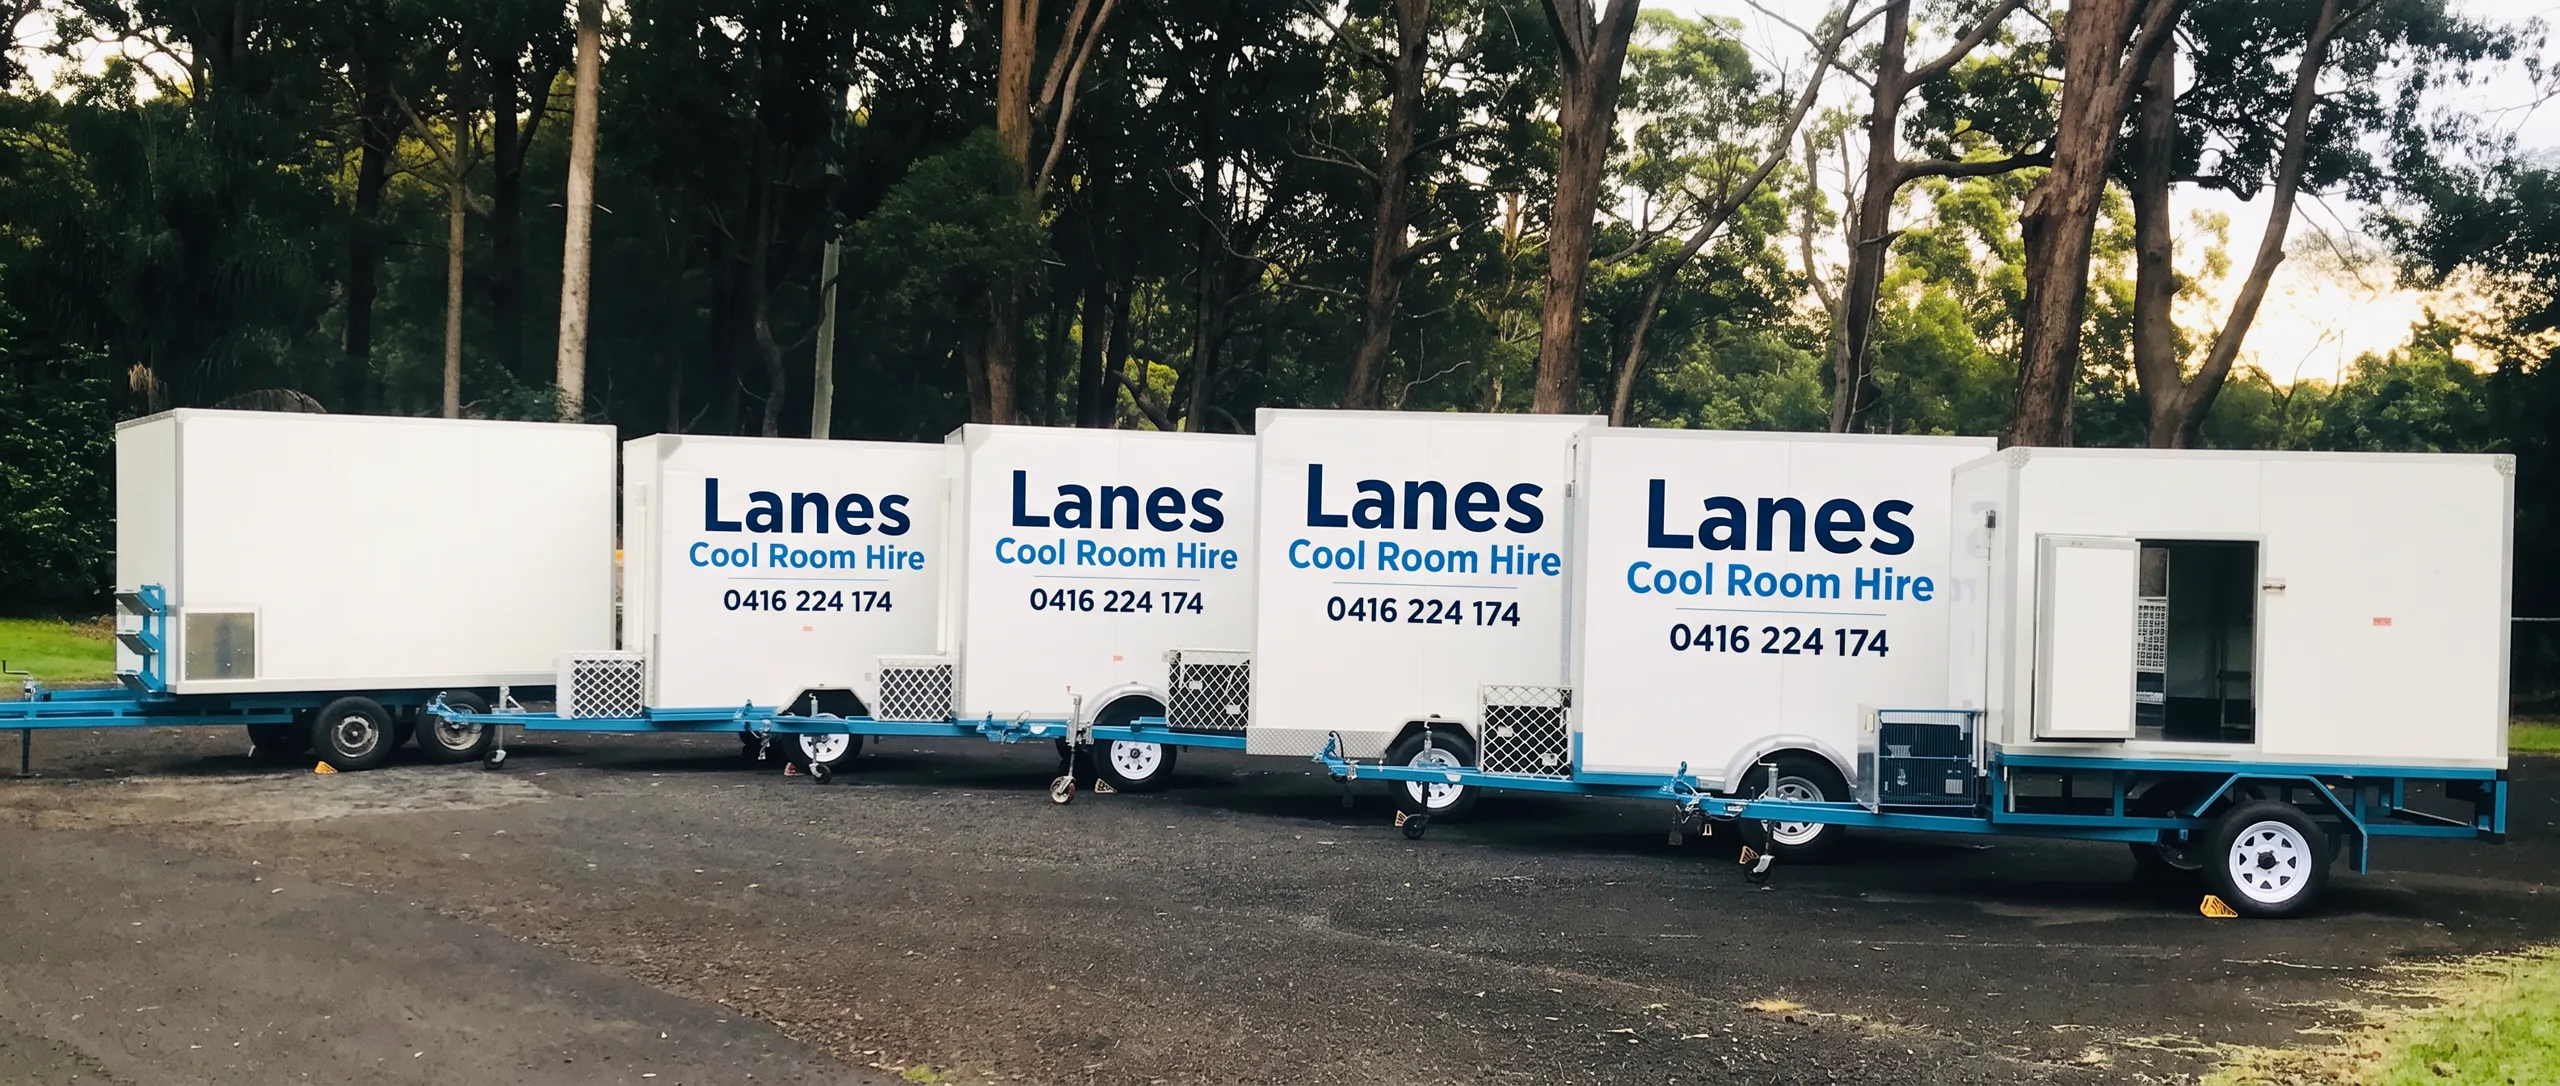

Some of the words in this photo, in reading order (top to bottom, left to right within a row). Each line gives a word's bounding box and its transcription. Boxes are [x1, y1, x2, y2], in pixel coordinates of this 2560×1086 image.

[704, 477, 911, 537] Lanes
[1012, 469, 1225, 534] Lanes
[1306, 463, 1544, 534] Lanes
[1647, 478, 1915, 556] Lanes
[689, 541, 758, 569] Cool
[769, 543, 856, 569] Room
[866, 544, 925, 571] Hire
[995, 536, 1066, 566] Cool
[1077, 539, 1166, 568] Room
[1176, 541, 1238, 570] Hire
[1288, 538, 1365, 571] Cool
[1377, 541, 1478, 574] Room
[1490, 544, 1562, 577] Hire
[1627, 560, 1714, 596] Cool
[1727, 563, 1841, 600] Room
[1854, 566, 1935, 602] Hire
[723, 589, 787, 612] 0416
[795, 589, 844, 612] 224
[851, 590, 893, 613] 174
[1029, 587, 1095, 613] 0416
[1103, 589, 1153, 614] 224
[1161, 591, 1204, 615] 174
[1326, 595, 1398, 623] 0416
[1407, 598, 1464, 626] 224
[1472, 600, 1521, 627] 174
[1669, 623, 1750, 654] 0416
[1760, 625, 1824, 656] 224
[1834, 628, 1889, 658] 174
